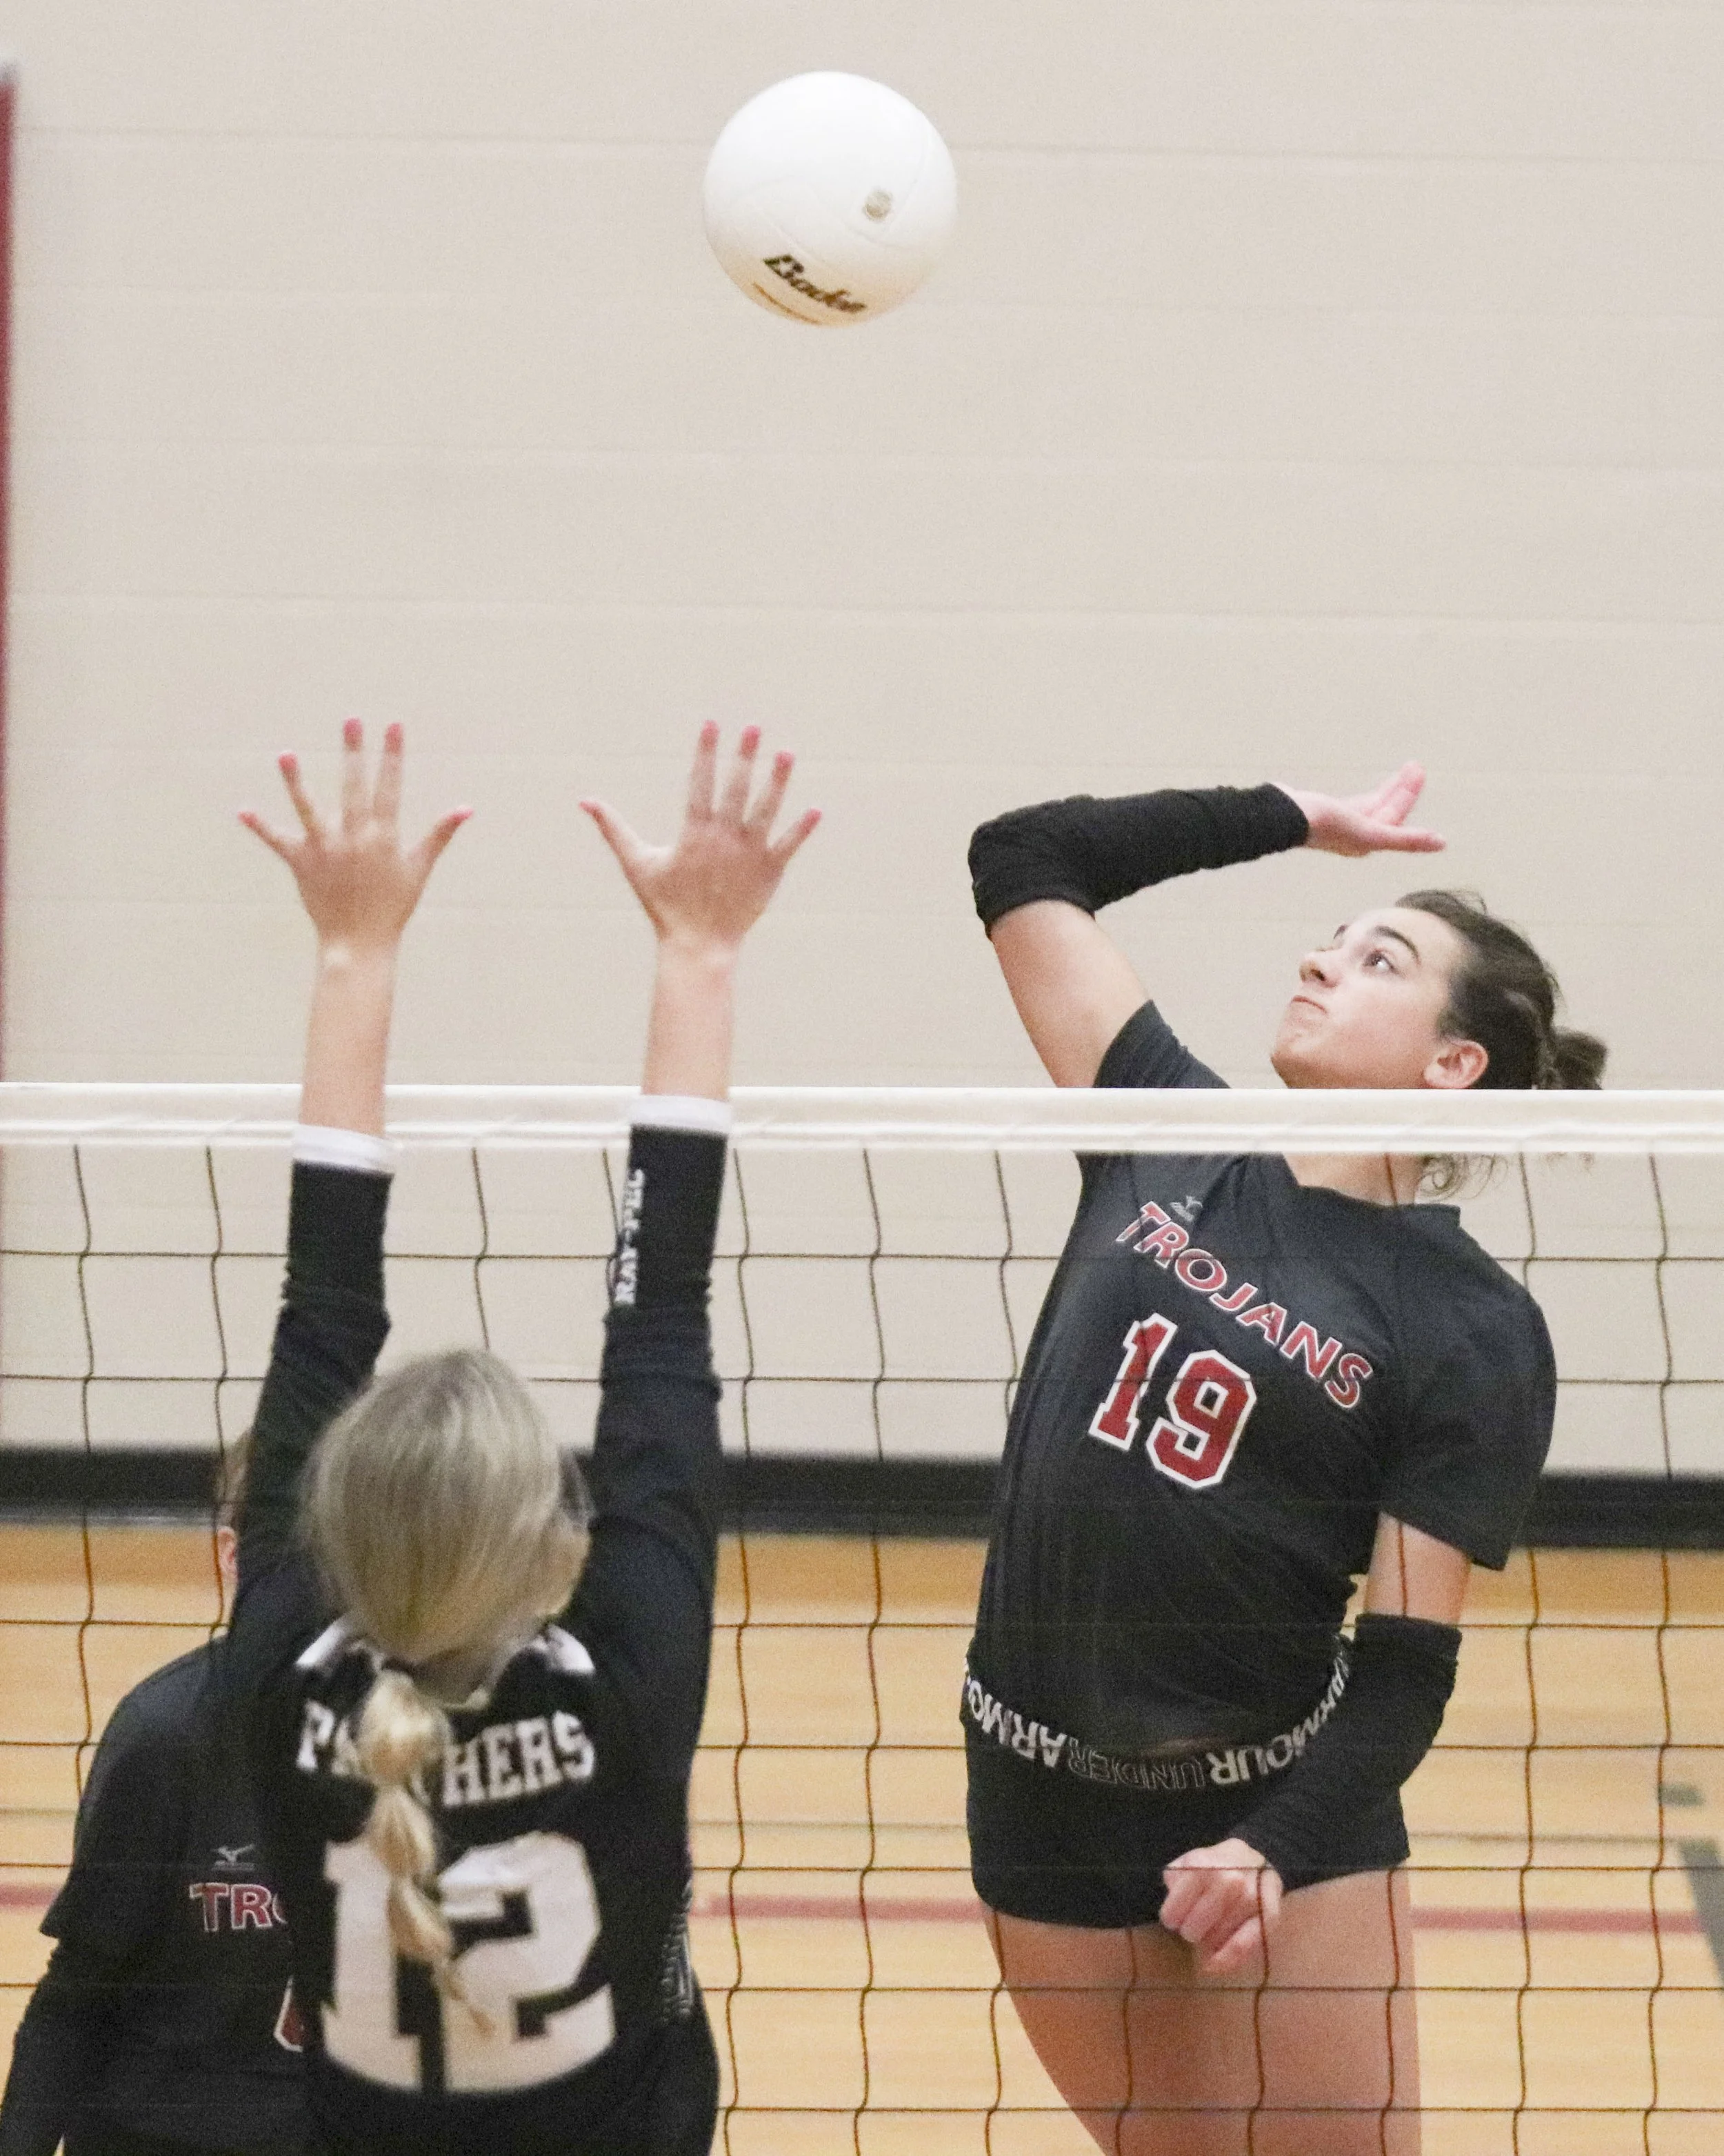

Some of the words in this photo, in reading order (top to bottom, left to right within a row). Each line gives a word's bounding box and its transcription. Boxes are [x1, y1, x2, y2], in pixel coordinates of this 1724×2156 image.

[1115, 1200, 1374, 1409] TROJANS
[1088, 1312, 1258, 1488] 19
[297, 1699, 596, 1808] PAHERS
[965, 1662, 1068, 1768] ARMO
[1069, 1736, 1206, 1790] UNDER
[321, 1830, 617, 2095] 12
